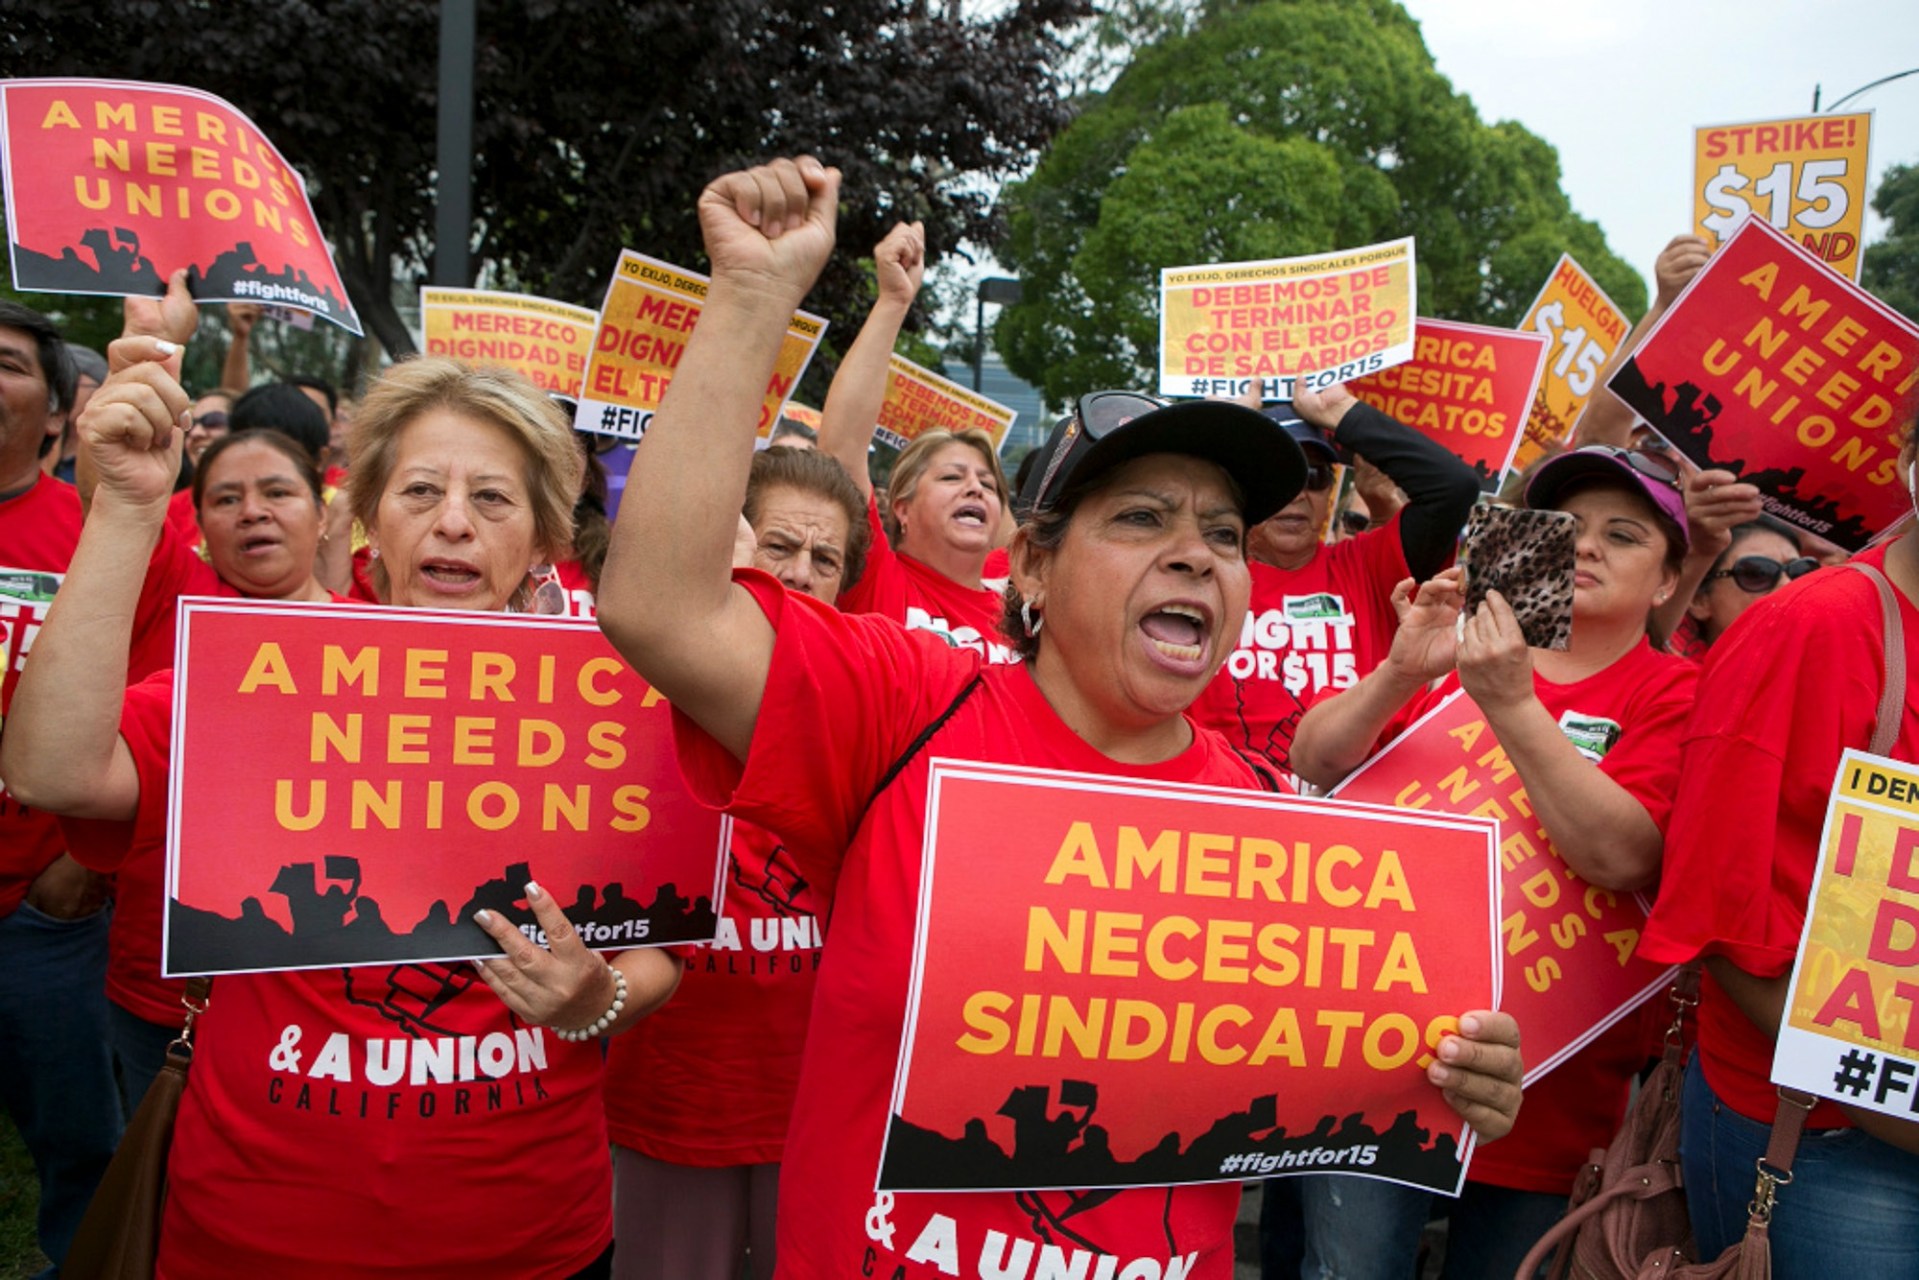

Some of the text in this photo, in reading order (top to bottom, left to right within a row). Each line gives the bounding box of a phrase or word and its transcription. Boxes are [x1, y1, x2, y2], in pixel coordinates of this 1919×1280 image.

[1706, 119, 1856, 159] STRIKE!
[93, 138, 289, 207] NEEDS
[74, 175, 310, 248] UNIONS
[1702, 159, 1850, 243] $15
[1168, 246, 1408, 283] YO EXIJO, DERECHOS SINDICALES PORQUE
[1788, 231, 1857, 263] ND
[624, 261, 640, 274] YO
[674, 278, 708, 296] DEREC
[1192, 266, 1391, 308] DEBEMOS DE
[1210, 293, 1372, 329] TERMINAR
[1553, 262, 1628, 346] HUELGA!
[452, 312, 577, 345] MEREZCO
[597, 323, 685, 369] DIGNI
[1185, 310, 1396, 353] CON EL ROBO
[1535, 300, 1608, 397] $15
[428, 338, 561, 366] DIGNIDAD
[1185, 331, 1390, 376] DE SALARIOS
[1415, 334, 1497, 373] RICA
[594, 365, 629, 398] EL
[894, 373, 972, 420] DEBEMOS
[973, 412, 998, 433] DE
[1358, 365, 1495, 405] CESITA
[900, 391, 967, 430] TERMIN
[1350, 390, 1508, 439] DICATOS
[1702, 337, 1898, 486] UNIONS
[1241, 608, 1356, 650] IGHT
[1283, 650, 1359, 698] $15
[309, 712, 628, 770] NEEDS
[1849, 768, 1862, 790] I
[274, 779, 653, 833] UNIONS
[1043, 821, 1416, 912] AMERICA
[1834, 812, 1864, 878] I
[518, 918, 650, 949] figtfor15
[750, 915, 824, 952] UNI
[1023, 905, 1430, 995] NECESITA
[268, 1024, 549, 1087] & A UNION
[268, 1076, 549, 1120] CALIFORNIA
[1219, 1145, 1379, 1176] #fightfor15
[865, 1190, 897, 1252] &
[904, 1212, 960, 1277] A
